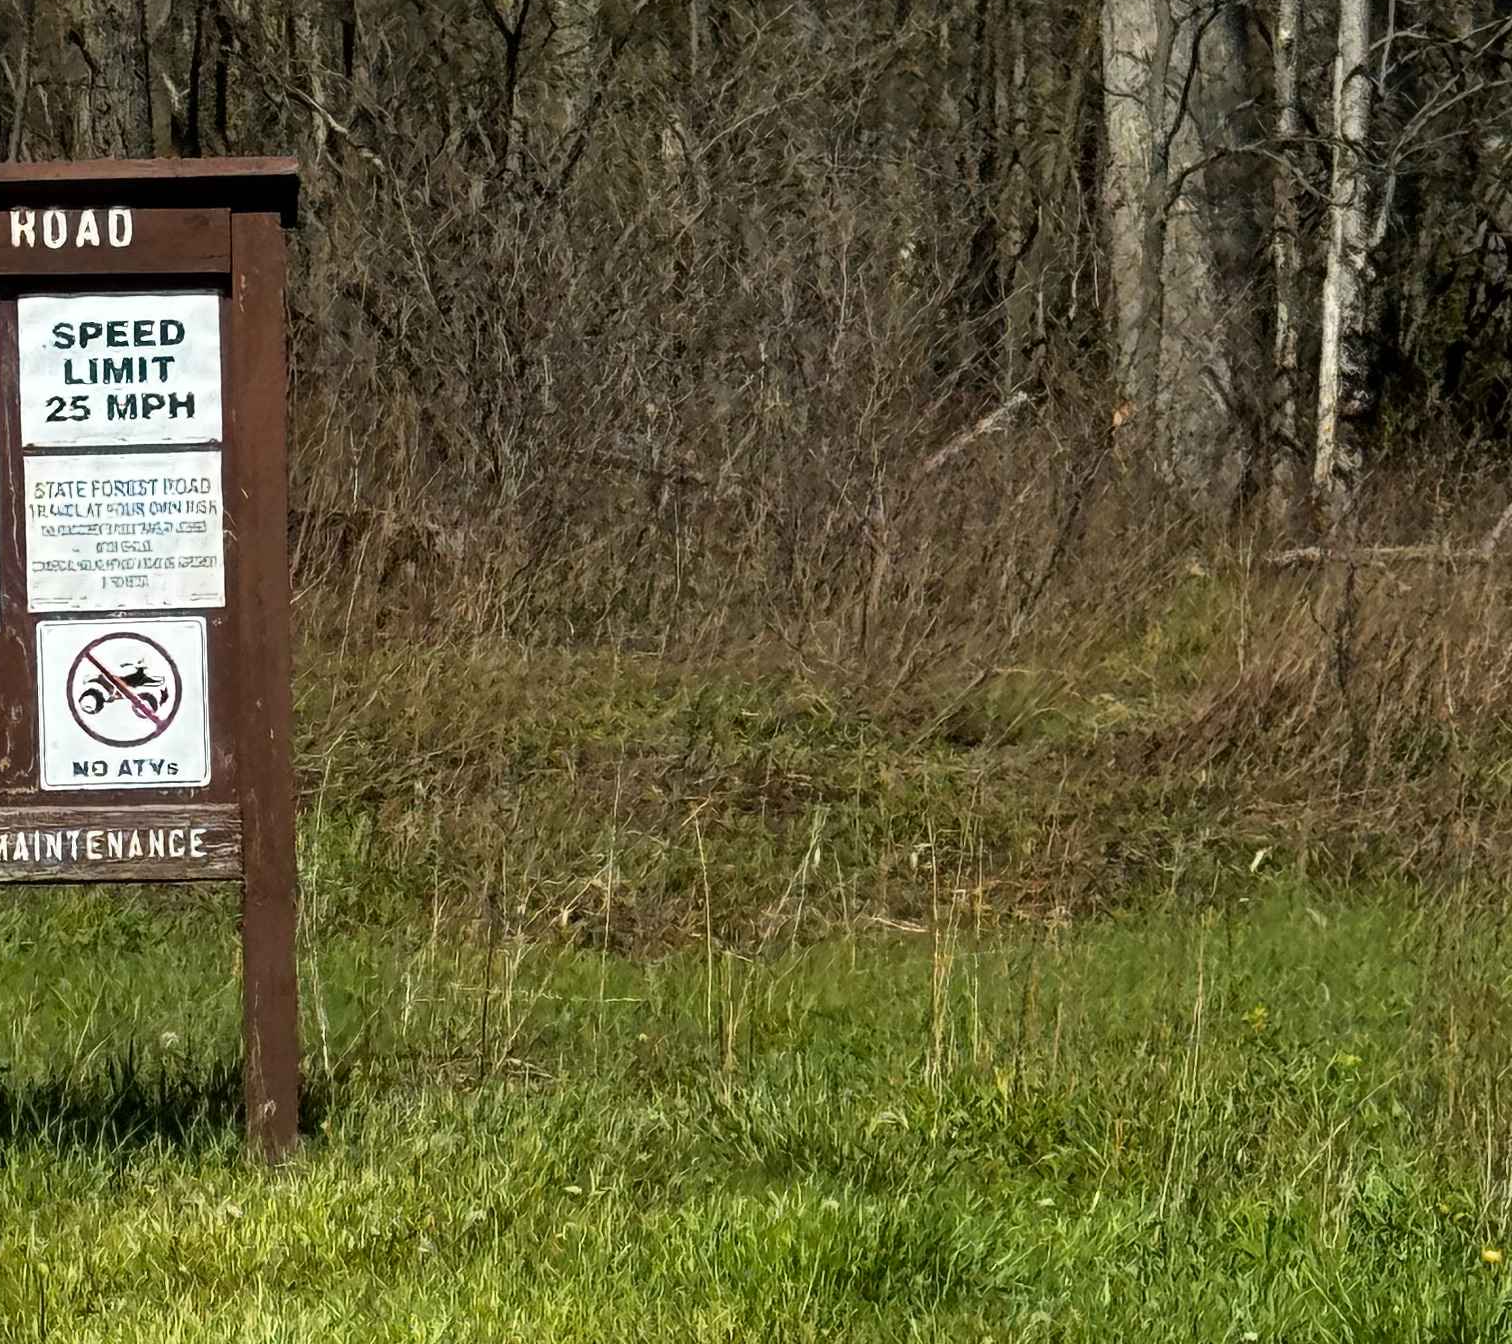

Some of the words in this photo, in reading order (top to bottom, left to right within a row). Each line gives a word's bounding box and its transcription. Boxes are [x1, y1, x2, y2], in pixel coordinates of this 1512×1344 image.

[10, 207, 134, 249] ROAD
[53, 320, 185, 349] SPEED
[65, 356, 175, 384] LIMIT
[46, 395, 91, 422] 25
[107, 392, 195, 420] MPH
[34, 481, 88, 499] STATE
[72, 760, 108, 777] NO
[117, 758, 180, 777] ATVs
